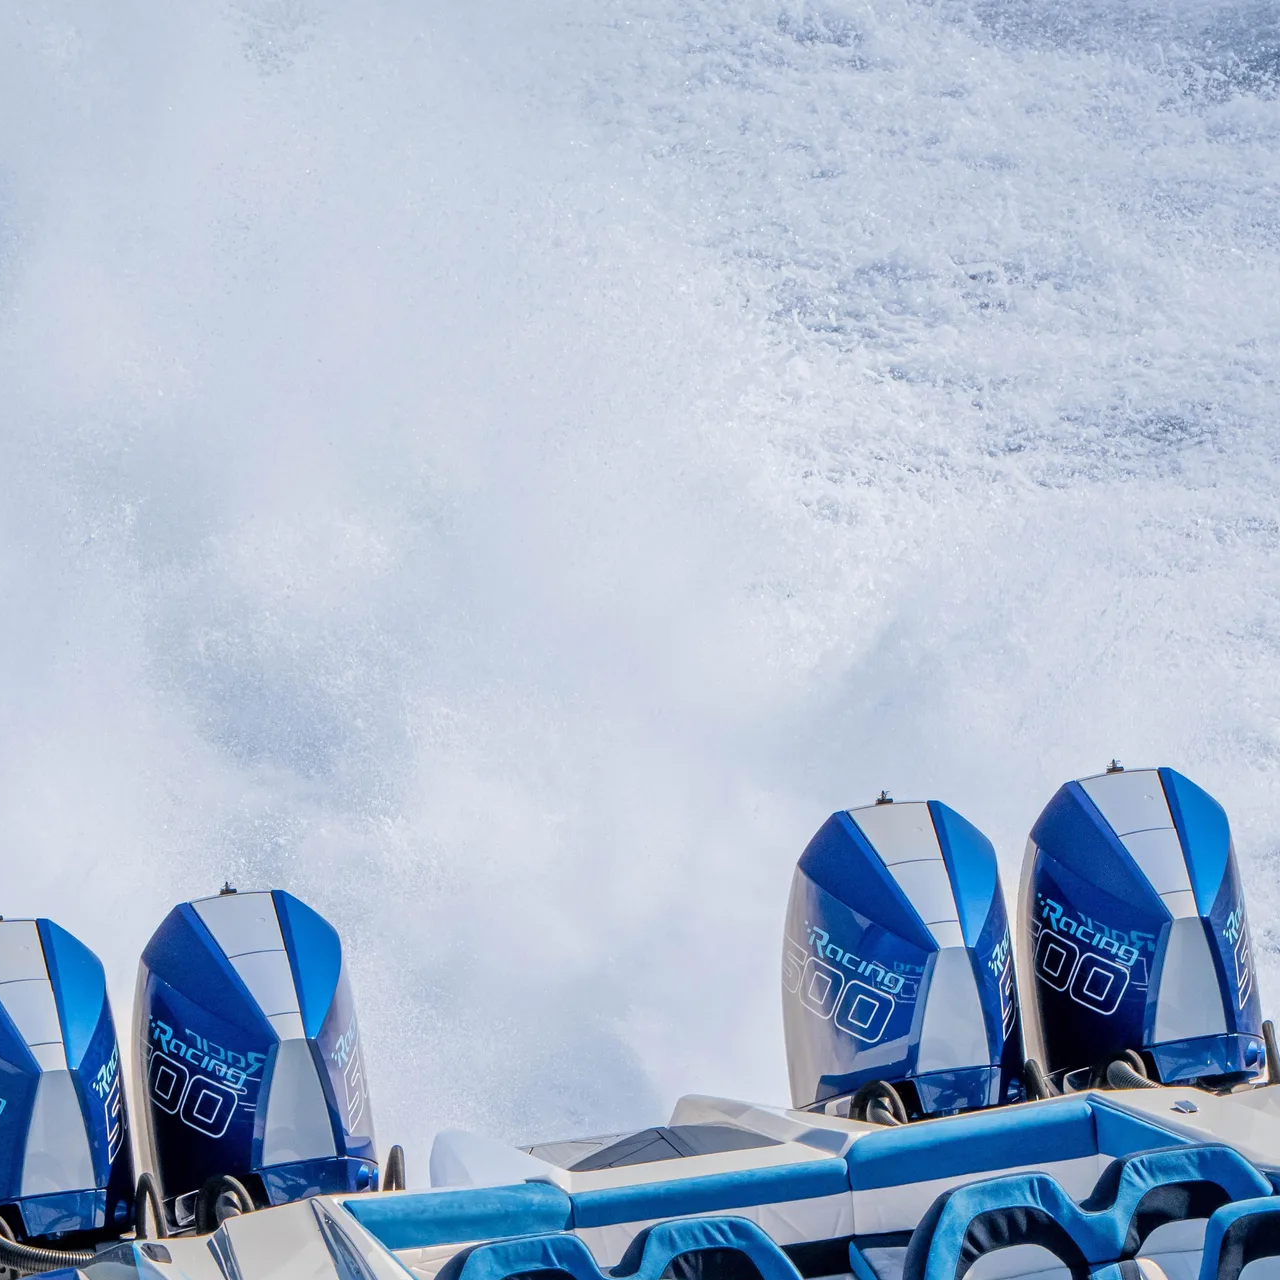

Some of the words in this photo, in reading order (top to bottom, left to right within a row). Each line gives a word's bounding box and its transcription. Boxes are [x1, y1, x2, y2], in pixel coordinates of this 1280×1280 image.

[805, 920, 905, 994] Racing
[1038, 893, 1139, 967] Racing
[782, 932, 895, 1043] 500
[149, 1015, 246, 1089] Racing
